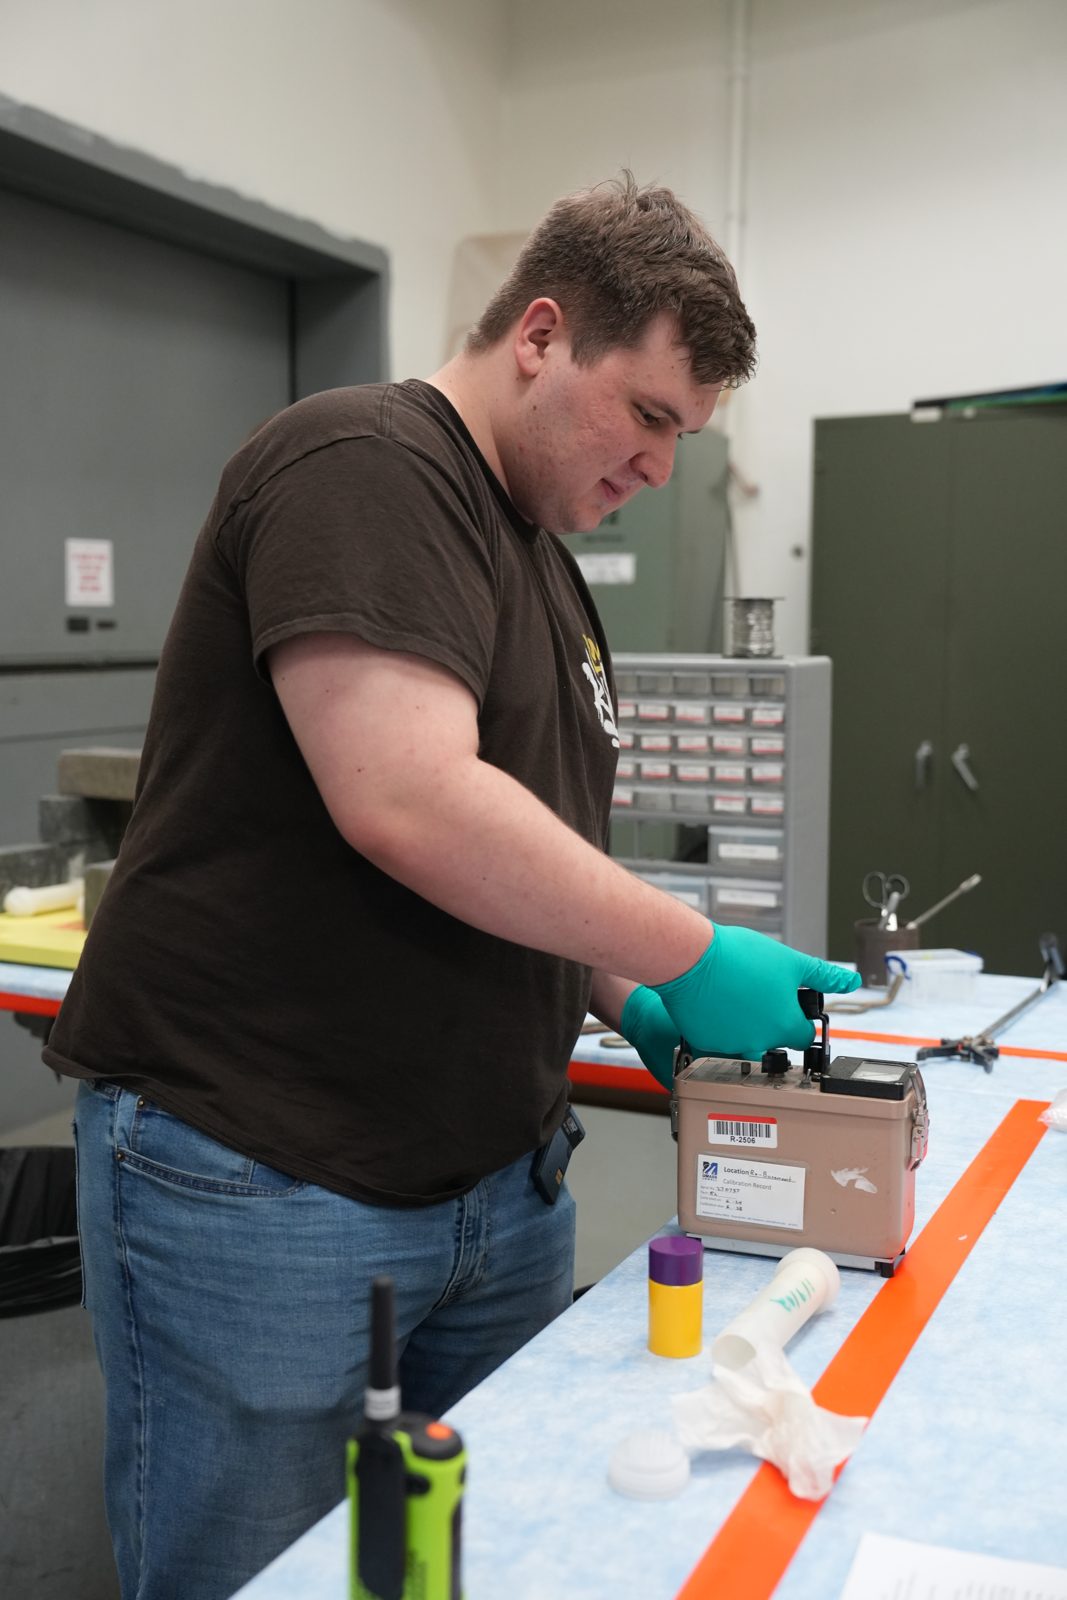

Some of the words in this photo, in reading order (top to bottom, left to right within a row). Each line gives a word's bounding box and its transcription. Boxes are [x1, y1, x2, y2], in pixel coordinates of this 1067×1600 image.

[730, 1135, 756, 1144] R-2506
[723, 1166, 750, 1176] Location
[723, 1178, 752, 1188] Calibration
[753, 1182, 772, 1191] Record
